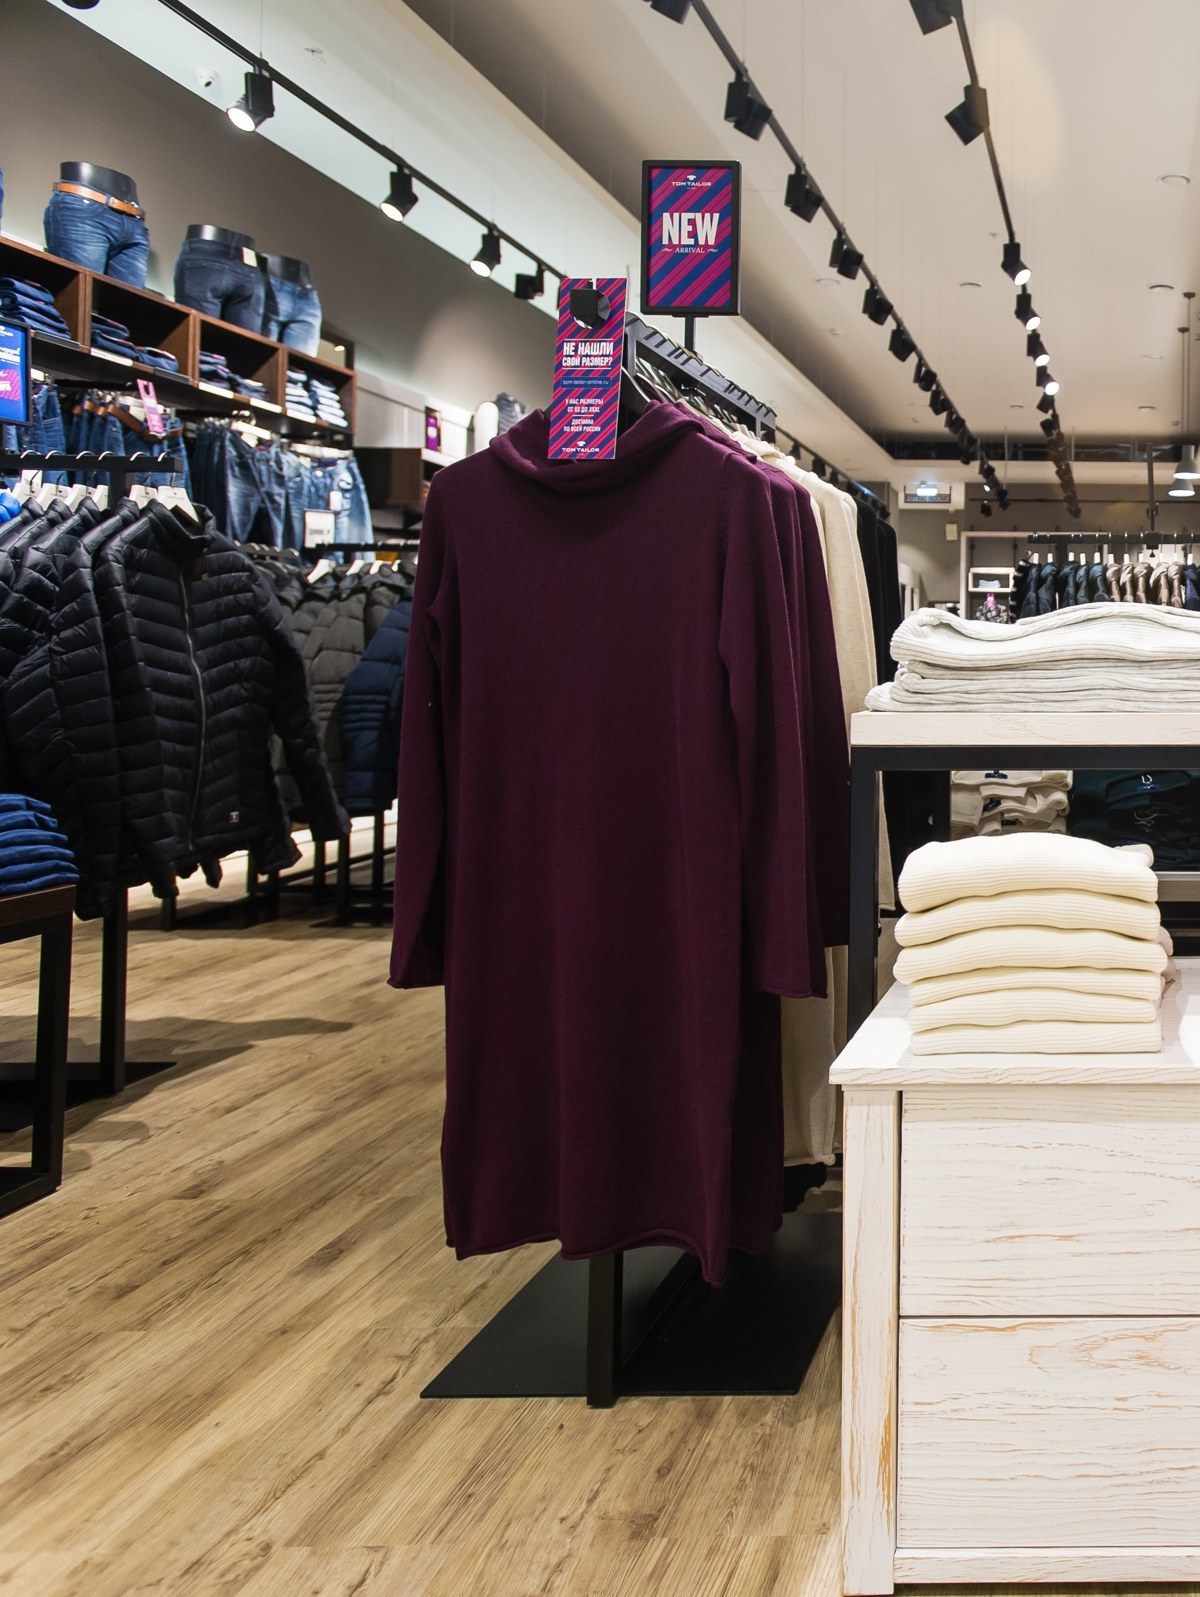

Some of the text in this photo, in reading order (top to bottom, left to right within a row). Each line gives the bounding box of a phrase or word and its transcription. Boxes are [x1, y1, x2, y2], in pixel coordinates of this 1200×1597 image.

[662, 212, 720, 245] NEW
[563, 342, 614, 356] НЕ НАШЛИ
[562, 356, 613, 366] СВОЙ РАЗМЕР?
